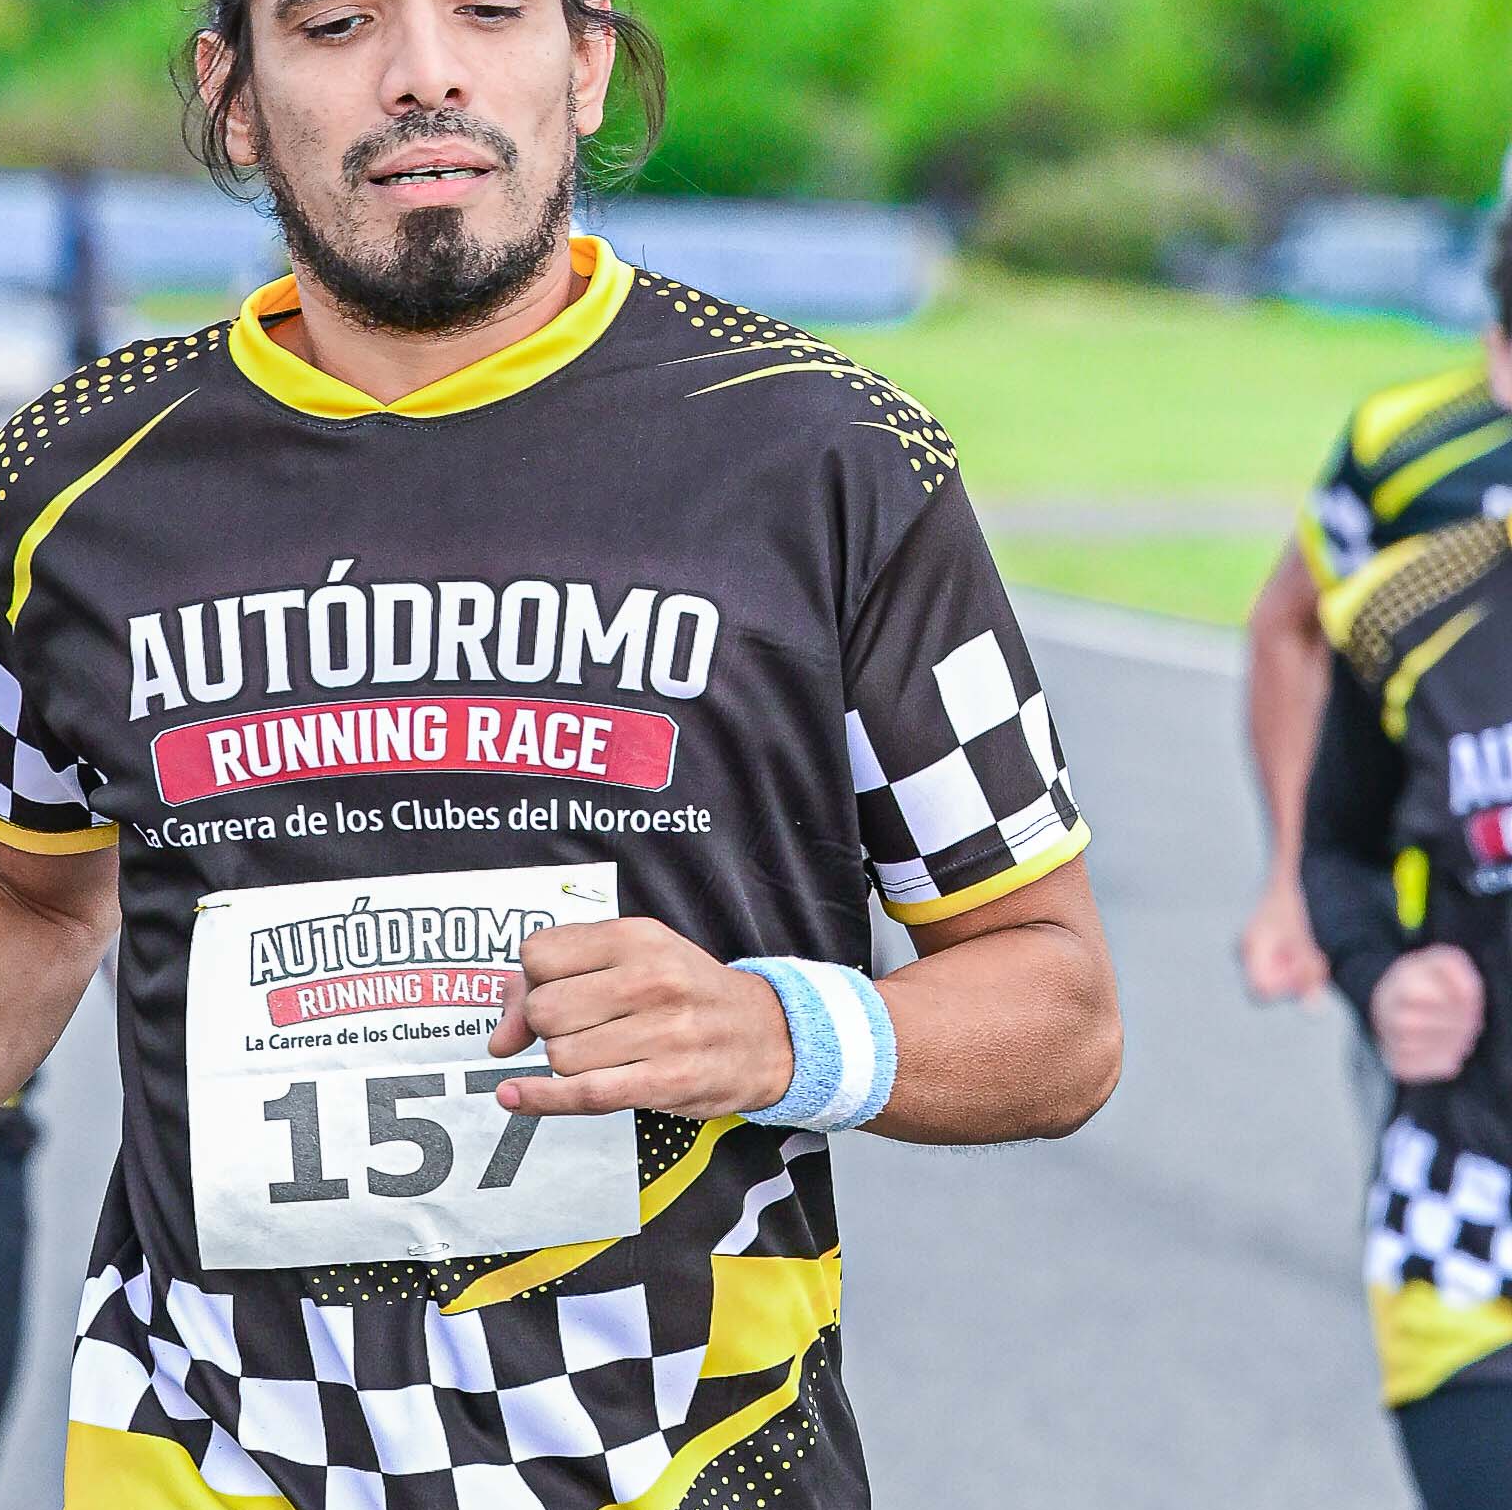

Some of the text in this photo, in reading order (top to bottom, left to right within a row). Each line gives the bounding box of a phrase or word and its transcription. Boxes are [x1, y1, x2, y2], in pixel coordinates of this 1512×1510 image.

[128, 558, 720, 722] AUTÓDROMO
[206, 706, 614, 787] RUNNING RACE
[162, 817, 276, 848] Carrera
[285, 804, 328, 838] de
[335, 801, 384, 834] los
[391, 799, 500, 831] Clubes
[507, 798, 558, 831] del
[568, 800, 712, 833] Noroeste
[296, 974, 504, 1018] RUNNING RACE
[246, 1036, 264, 1051] La
[269, 1033, 332, 1051] Carrera
[337, 1028, 359, 1044] de
[363, 1026, 388, 1042] los
[393, 1021, 450, 1040] Clubes
[455, 1019, 481, 1036] del
[263, 1065, 553, 1203] 157
